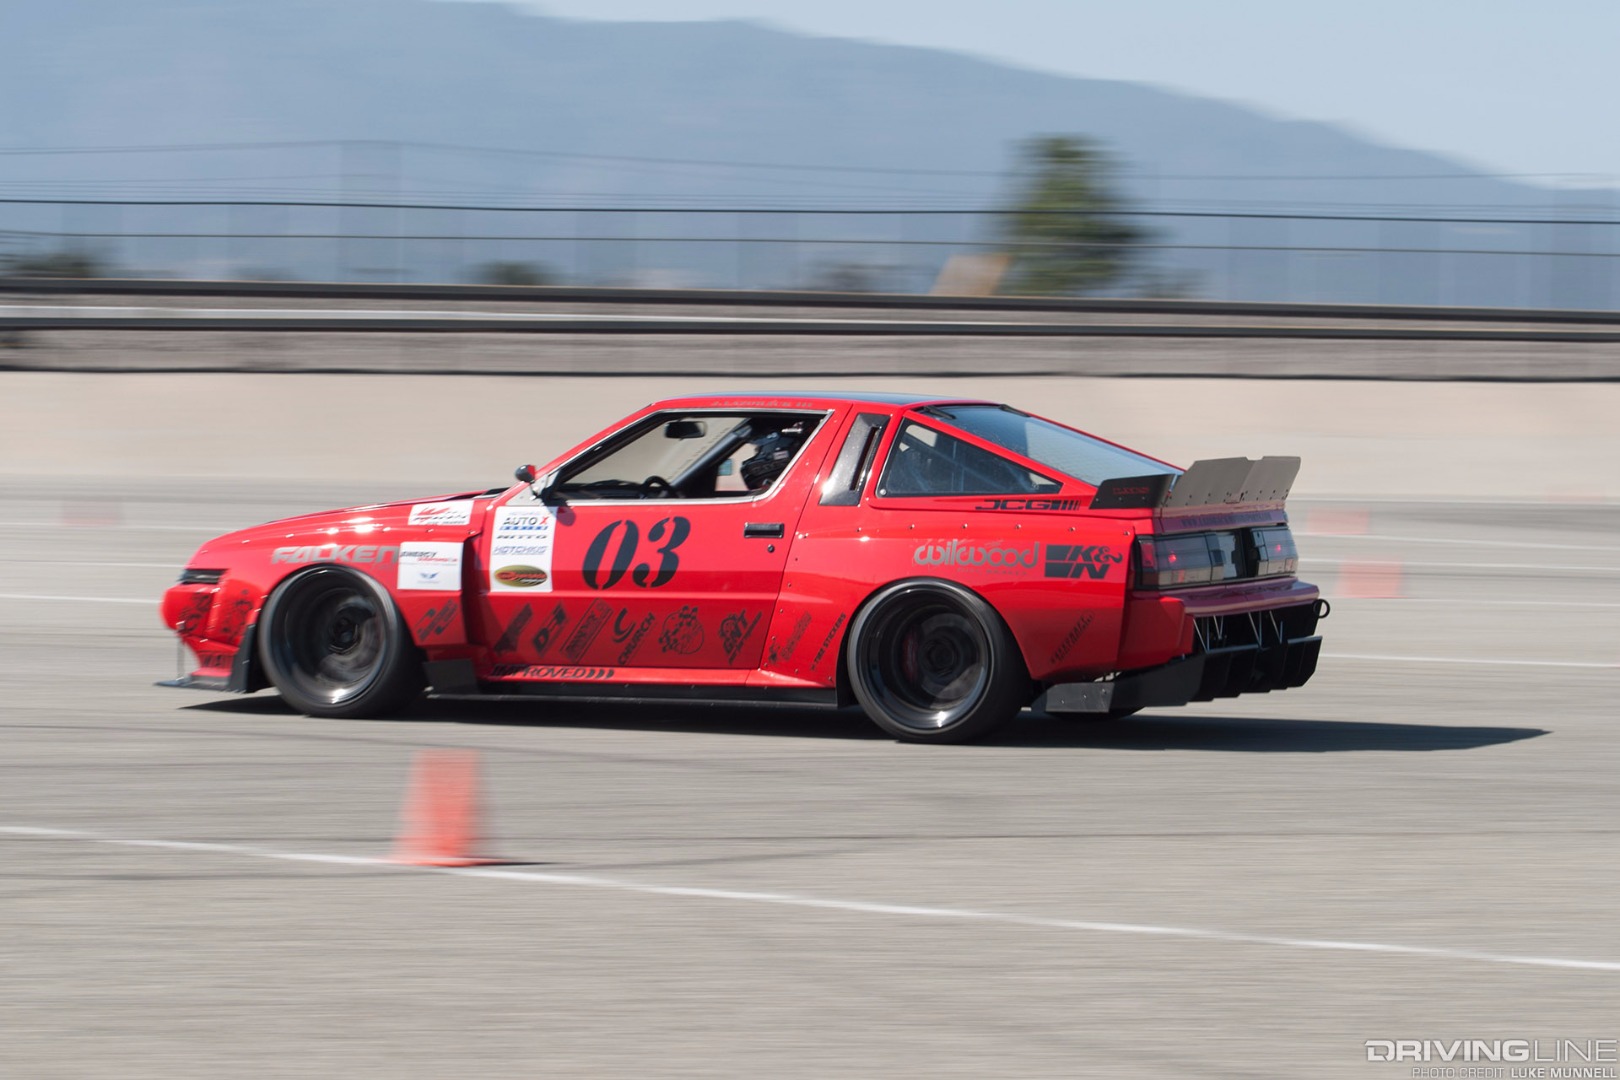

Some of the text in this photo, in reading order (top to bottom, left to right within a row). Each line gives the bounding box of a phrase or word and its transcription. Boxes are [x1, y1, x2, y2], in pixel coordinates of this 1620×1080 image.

[503, 516, 538, 526] AUTO
[271, 545, 400, 565] FALKEN
[582, 516, 691, 590] 03
[913, 538, 1040, 569] wilwood
[617, 611, 656, 666] CHURCH
